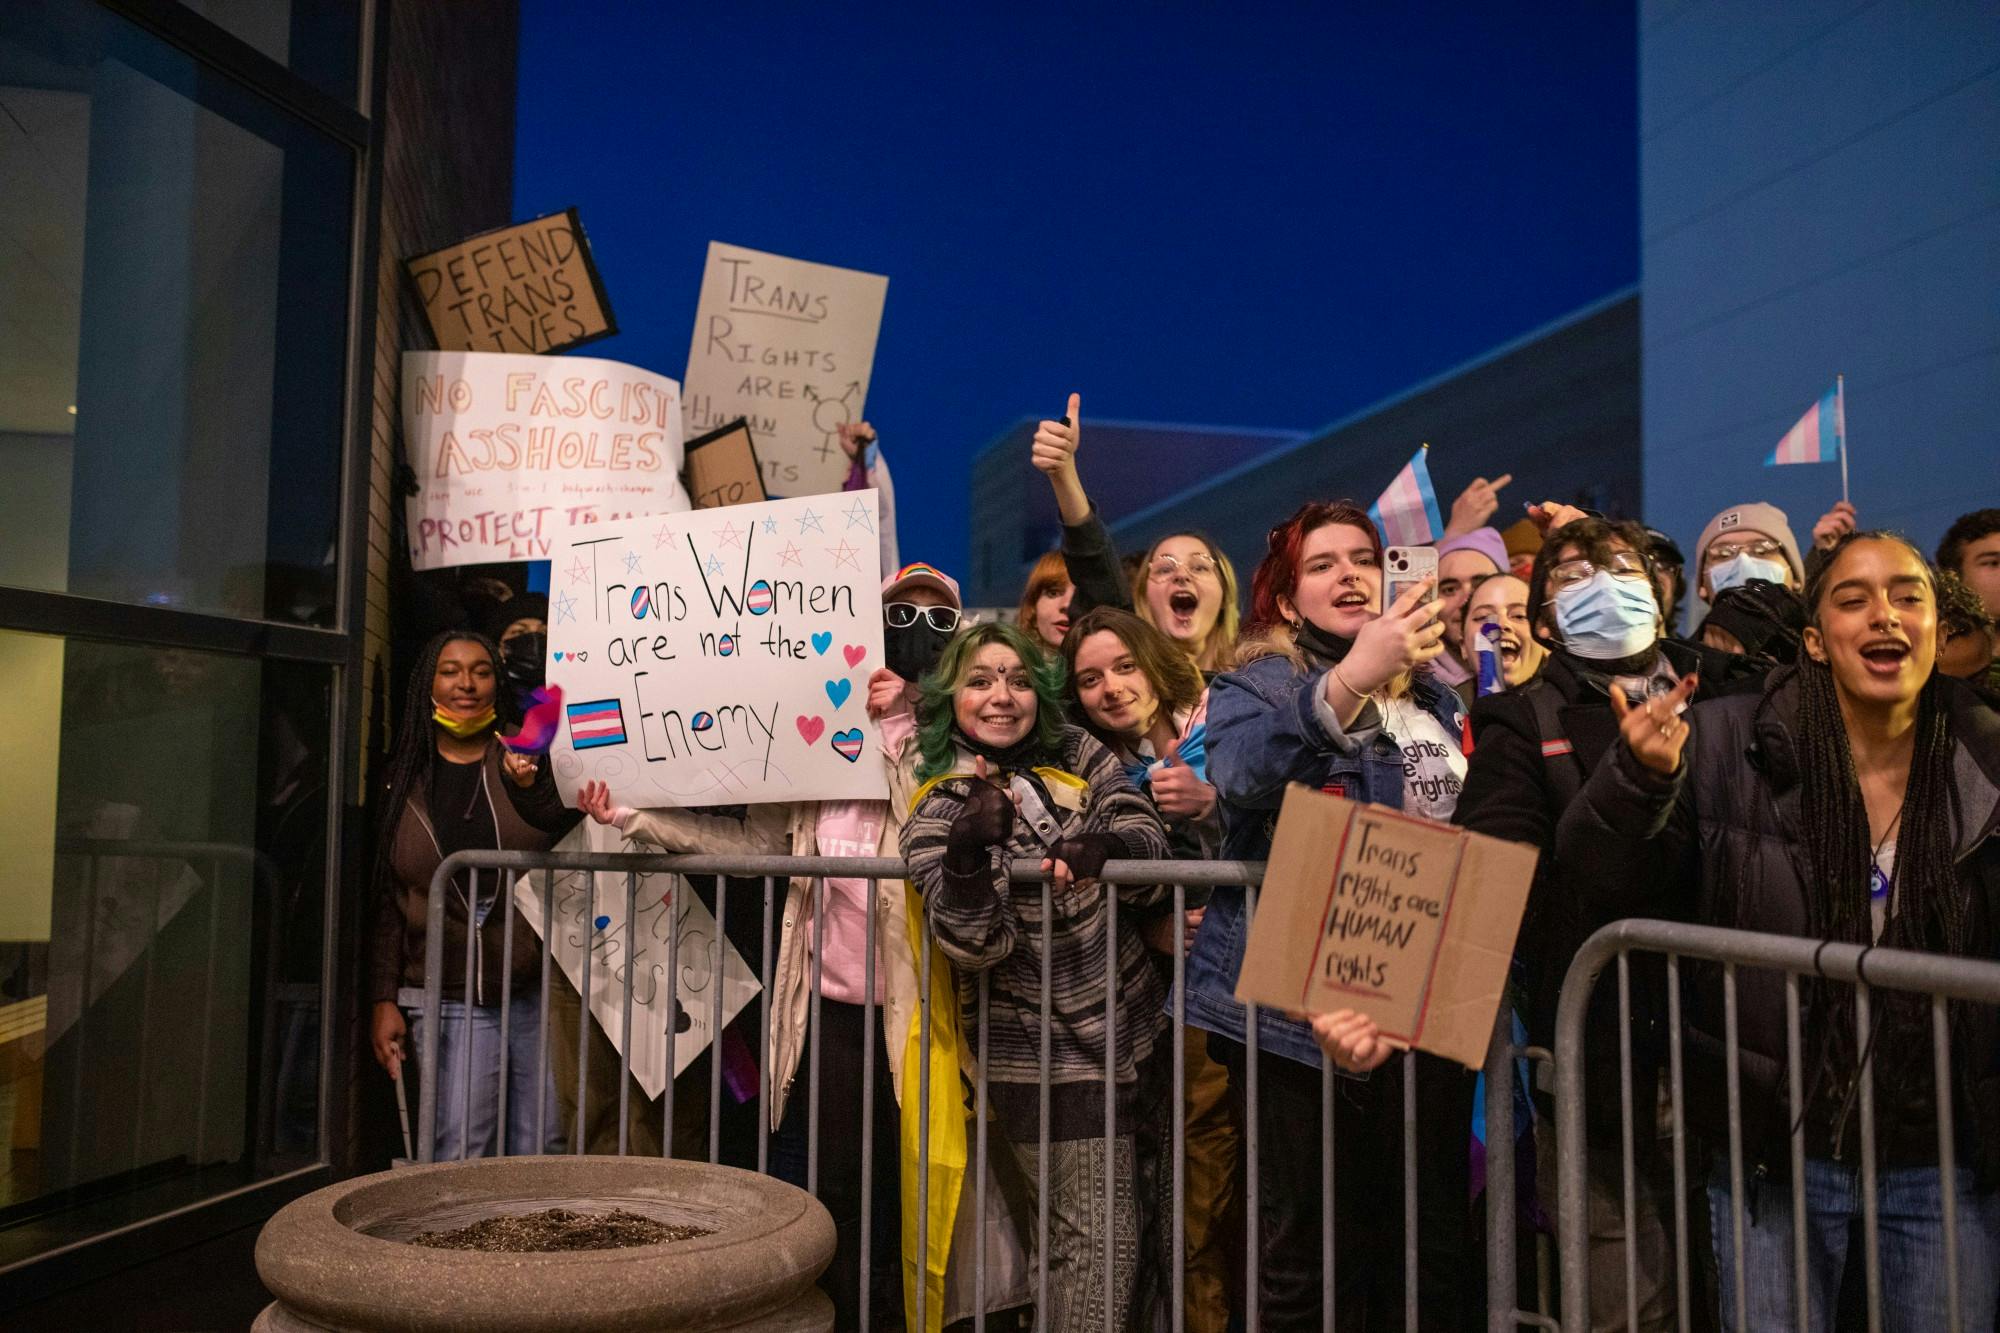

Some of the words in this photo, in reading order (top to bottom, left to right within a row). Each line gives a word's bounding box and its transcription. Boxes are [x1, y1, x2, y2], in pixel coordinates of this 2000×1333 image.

[413, 227, 576, 306] DEFEND
[720, 257, 828, 320] TRANS
[448, 269, 575, 335] TRANS
[707, 315, 836, 372] RIGHTS
[415, 374, 473, 415] NO
[506, 372, 674, 429] FASCIST
[738, 376, 795, 399] ARE
[417, 506, 553, 553] PROTECT
[571, 537, 687, 624] Trans
[687, 521, 855, 619] Women
[608, 635, 676, 666] are
[699, 621, 741, 657] not
[760, 622, 807, 659] the
[634, 672, 778, 782] Enemy
[1402, 740, 1449, 763] ghts
[1410, 775, 1463, 802] rights
[1356, 819, 1422, 878] Trans
[1339, 871, 1402, 914] rights
[1407, 894, 1439, 919] are
[1328, 907, 1415, 949] HUMAN
[1326, 952, 1388, 988] rights
